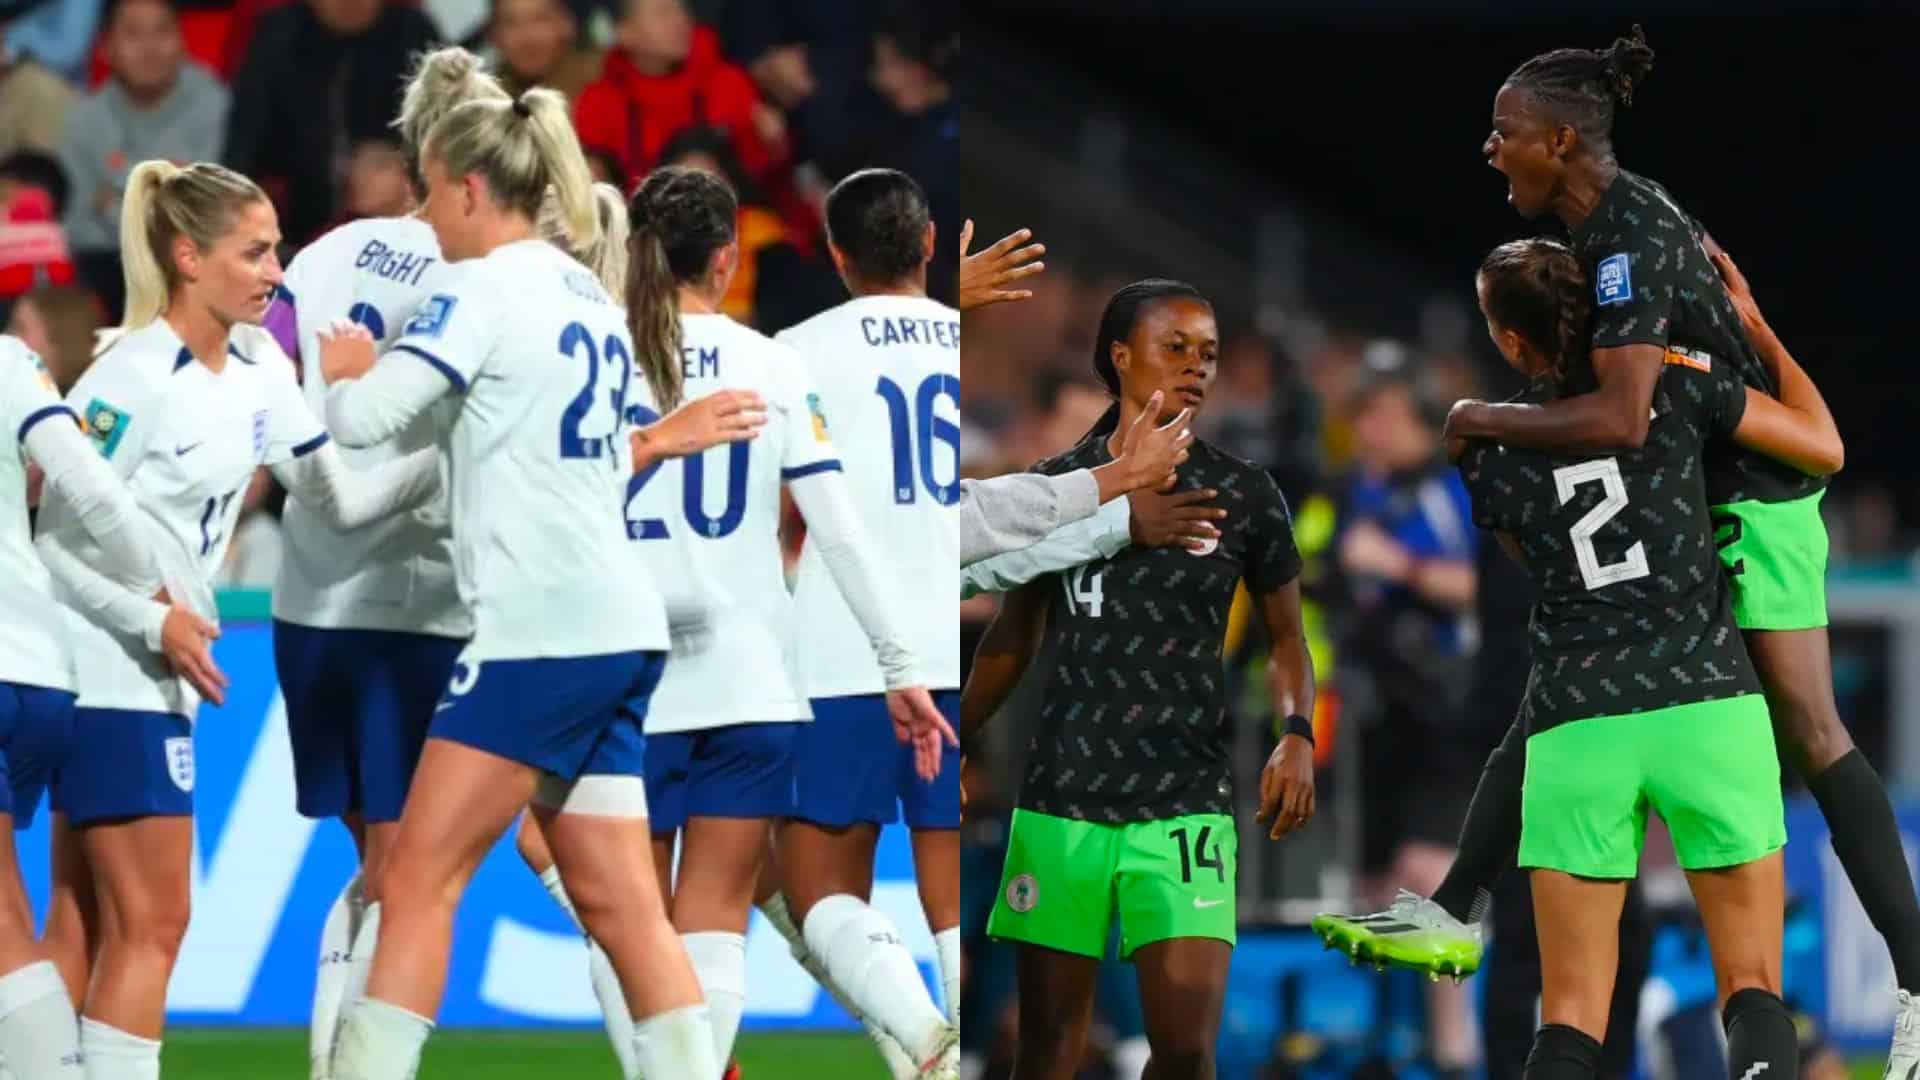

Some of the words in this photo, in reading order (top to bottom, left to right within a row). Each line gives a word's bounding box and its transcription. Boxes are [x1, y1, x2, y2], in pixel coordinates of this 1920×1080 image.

[861, 316, 960, 349] CARTER
[623, 403, 750, 540] 20
[875, 373, 960, 506] 16
[1552, 456, 1651, 590] 2
[1168, 826, 1225, 884] 14
